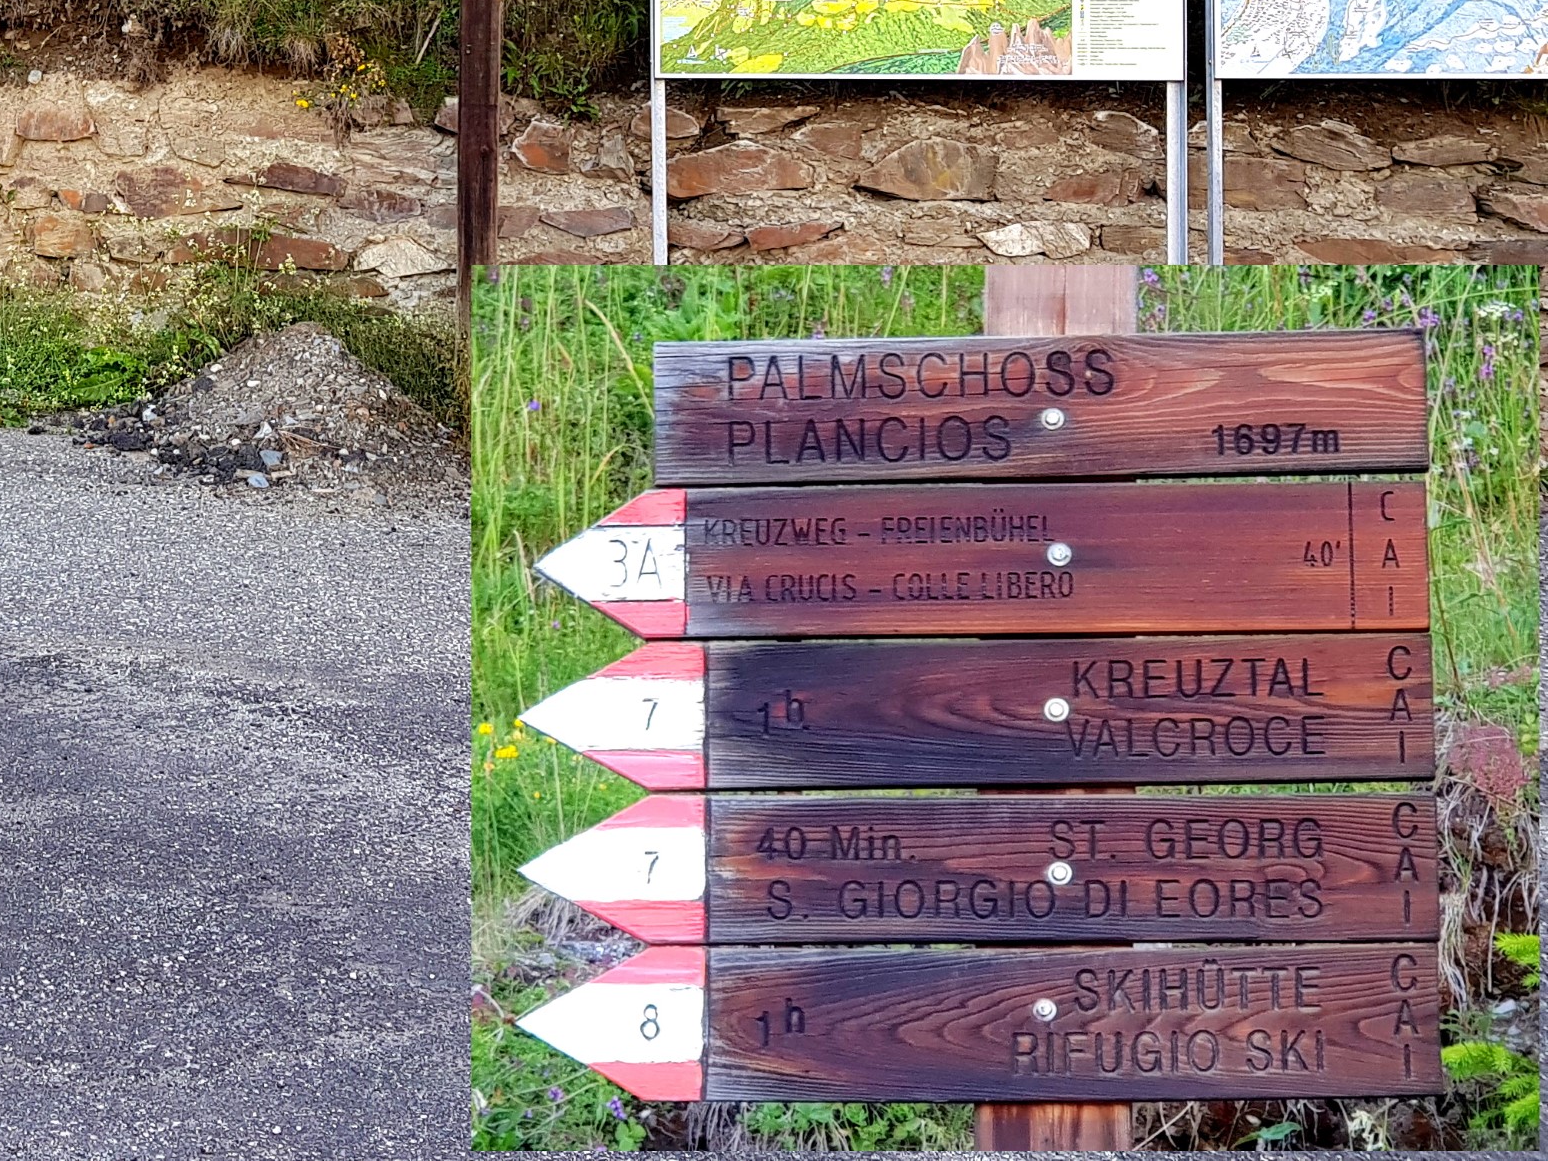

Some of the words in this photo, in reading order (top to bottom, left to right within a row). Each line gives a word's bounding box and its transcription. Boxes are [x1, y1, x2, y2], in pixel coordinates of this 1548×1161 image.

[727, 349, 1115, 401] PALMSCHOSS
[727, 415, 1012, 466] PLANCIOS
[1211, 423, 1341, 456] 1697m
[702, 516, 847, 547] KREUZWEG
[881, 509, 1055, 545] FREIENBÜHEL
[609, 539, 661, 589] 3A
[707, 574, 753, 604] VIA
[764, 572, 857, 603] CRUCIS
[892, 572, 972, 602] COLLE
[982, 571, 1074, 600] LIBERO
[1072, 658, 1325, 700] KREUZTAL
[642, 697, 659, 731] 7
[1065, 715, 1327, 758] VALCROCE
[757, 827, 807, 861] 40
[830, 825, 918, 861] Min.
[1049, 818, 1117, 861] ST.
[1146, 816, 1325, 860] GEORG
[645, 850, 660, 885] 7
[766, 880, 810, 921] S.
[838, 879, 1056, 920] GIORGIO
[1084, 878, 1128, 919] DI
[1155, 878, 1325, 919] EORES
[1074, 958, 1322, 1012] SKIHÜTTE
[639, 1003, 661, 1042] 8
[1011, 1028, 1220, 1075] RIFUGIO
[1245, 1028, 1325, 1073] SKI
